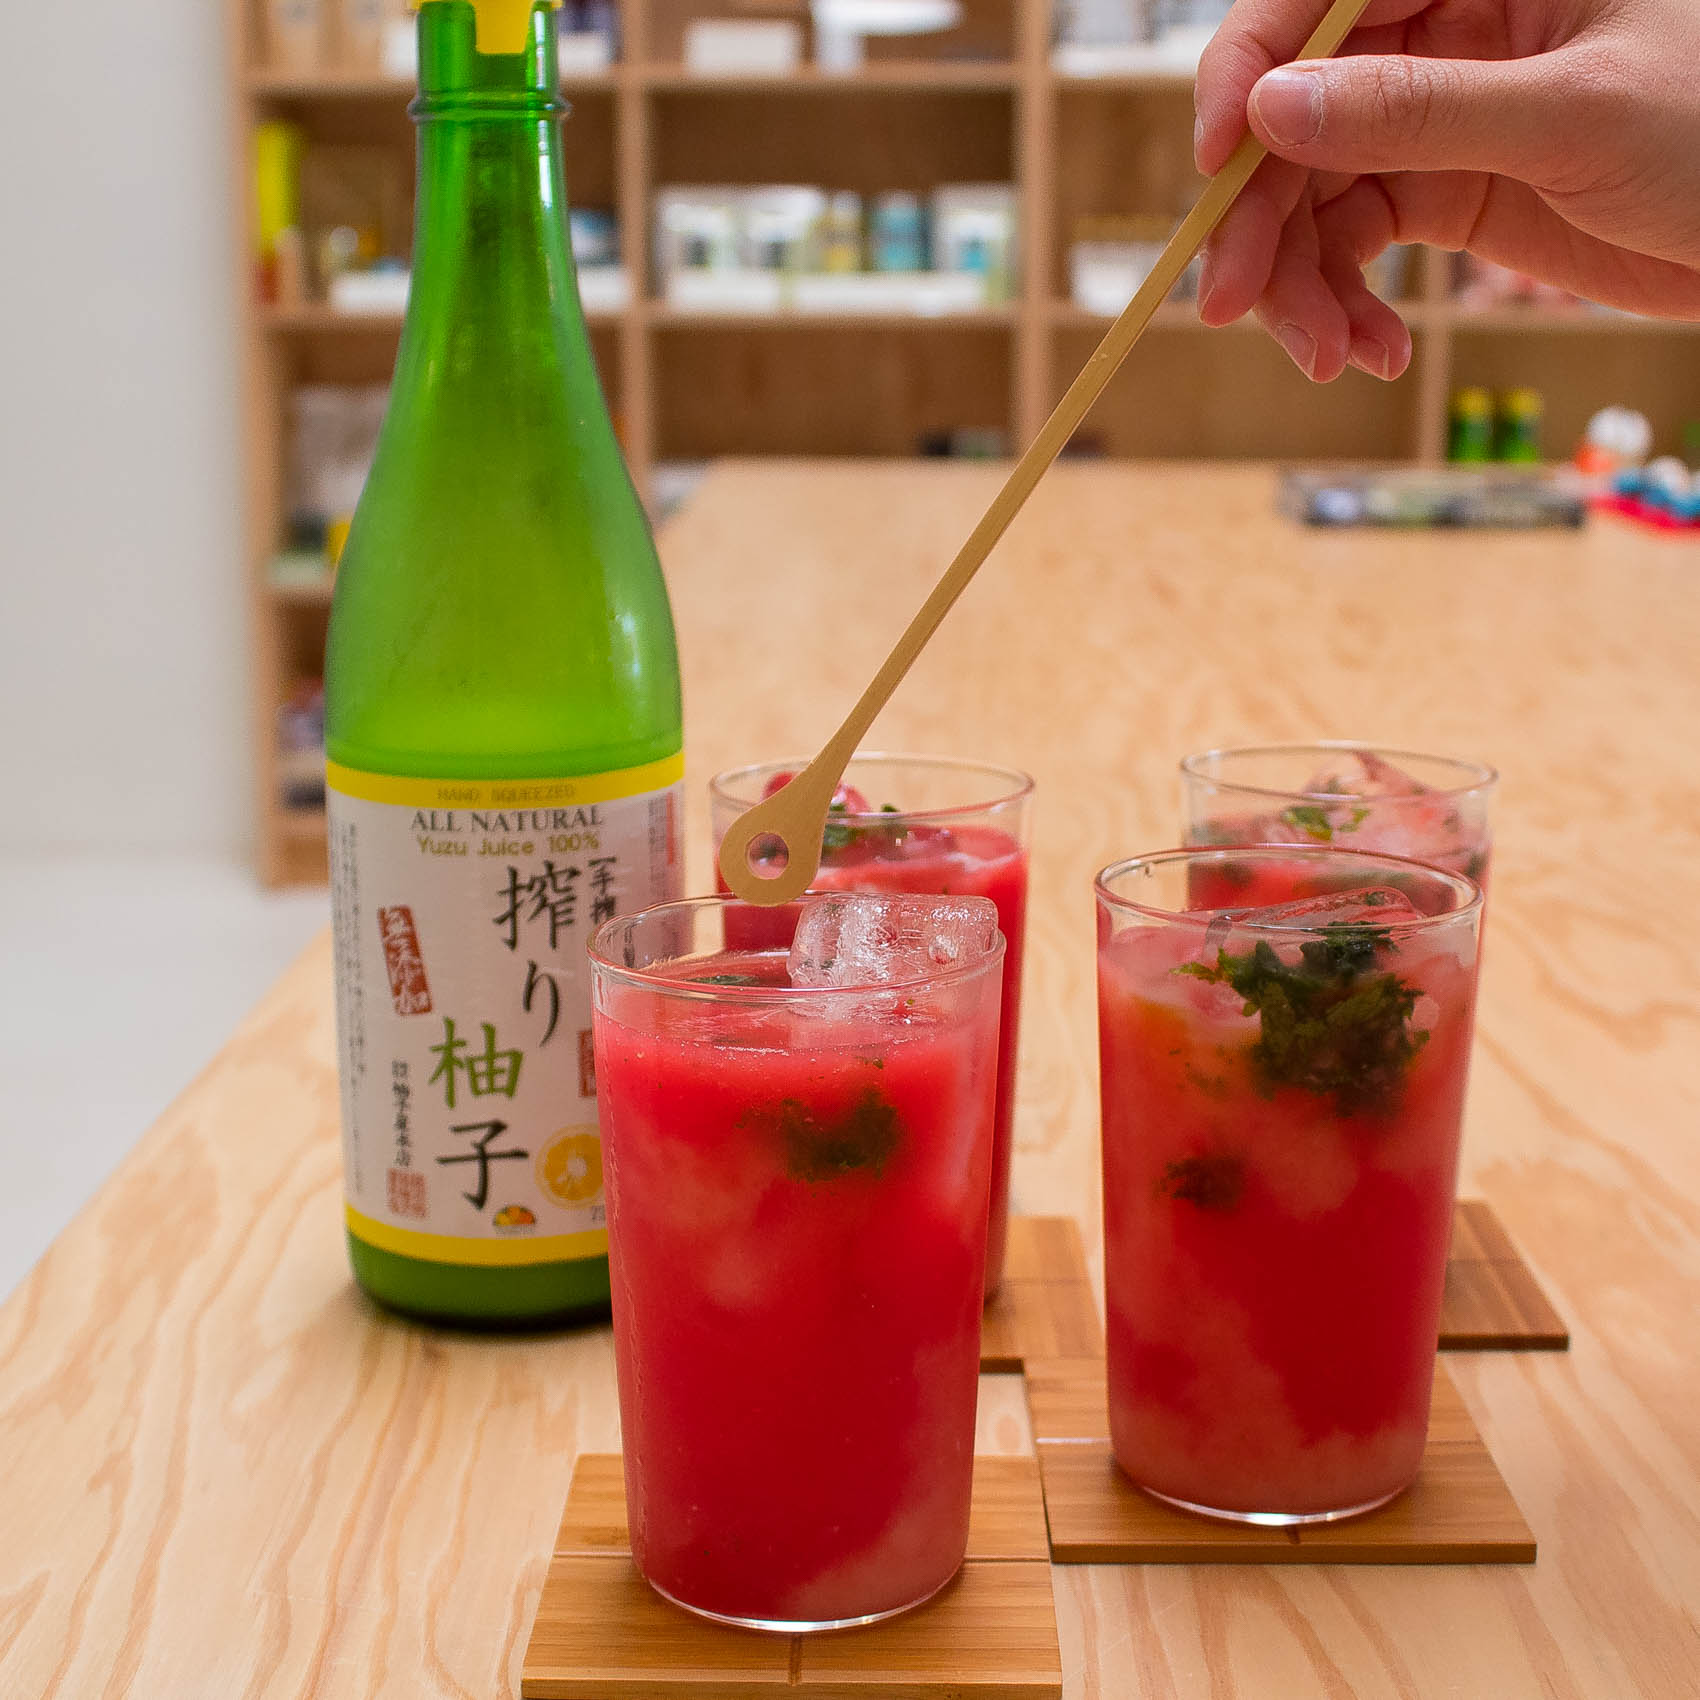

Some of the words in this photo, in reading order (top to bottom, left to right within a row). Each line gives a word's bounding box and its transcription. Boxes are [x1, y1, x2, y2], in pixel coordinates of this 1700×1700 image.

[411, 809, 462, 832] ALL
[471, 805, 604, 832] NATURAL
[417, 835, 468, 857] Yuzu
[478, 838, 535, 857] Juice
[548, 831, 600, 854] 100%
